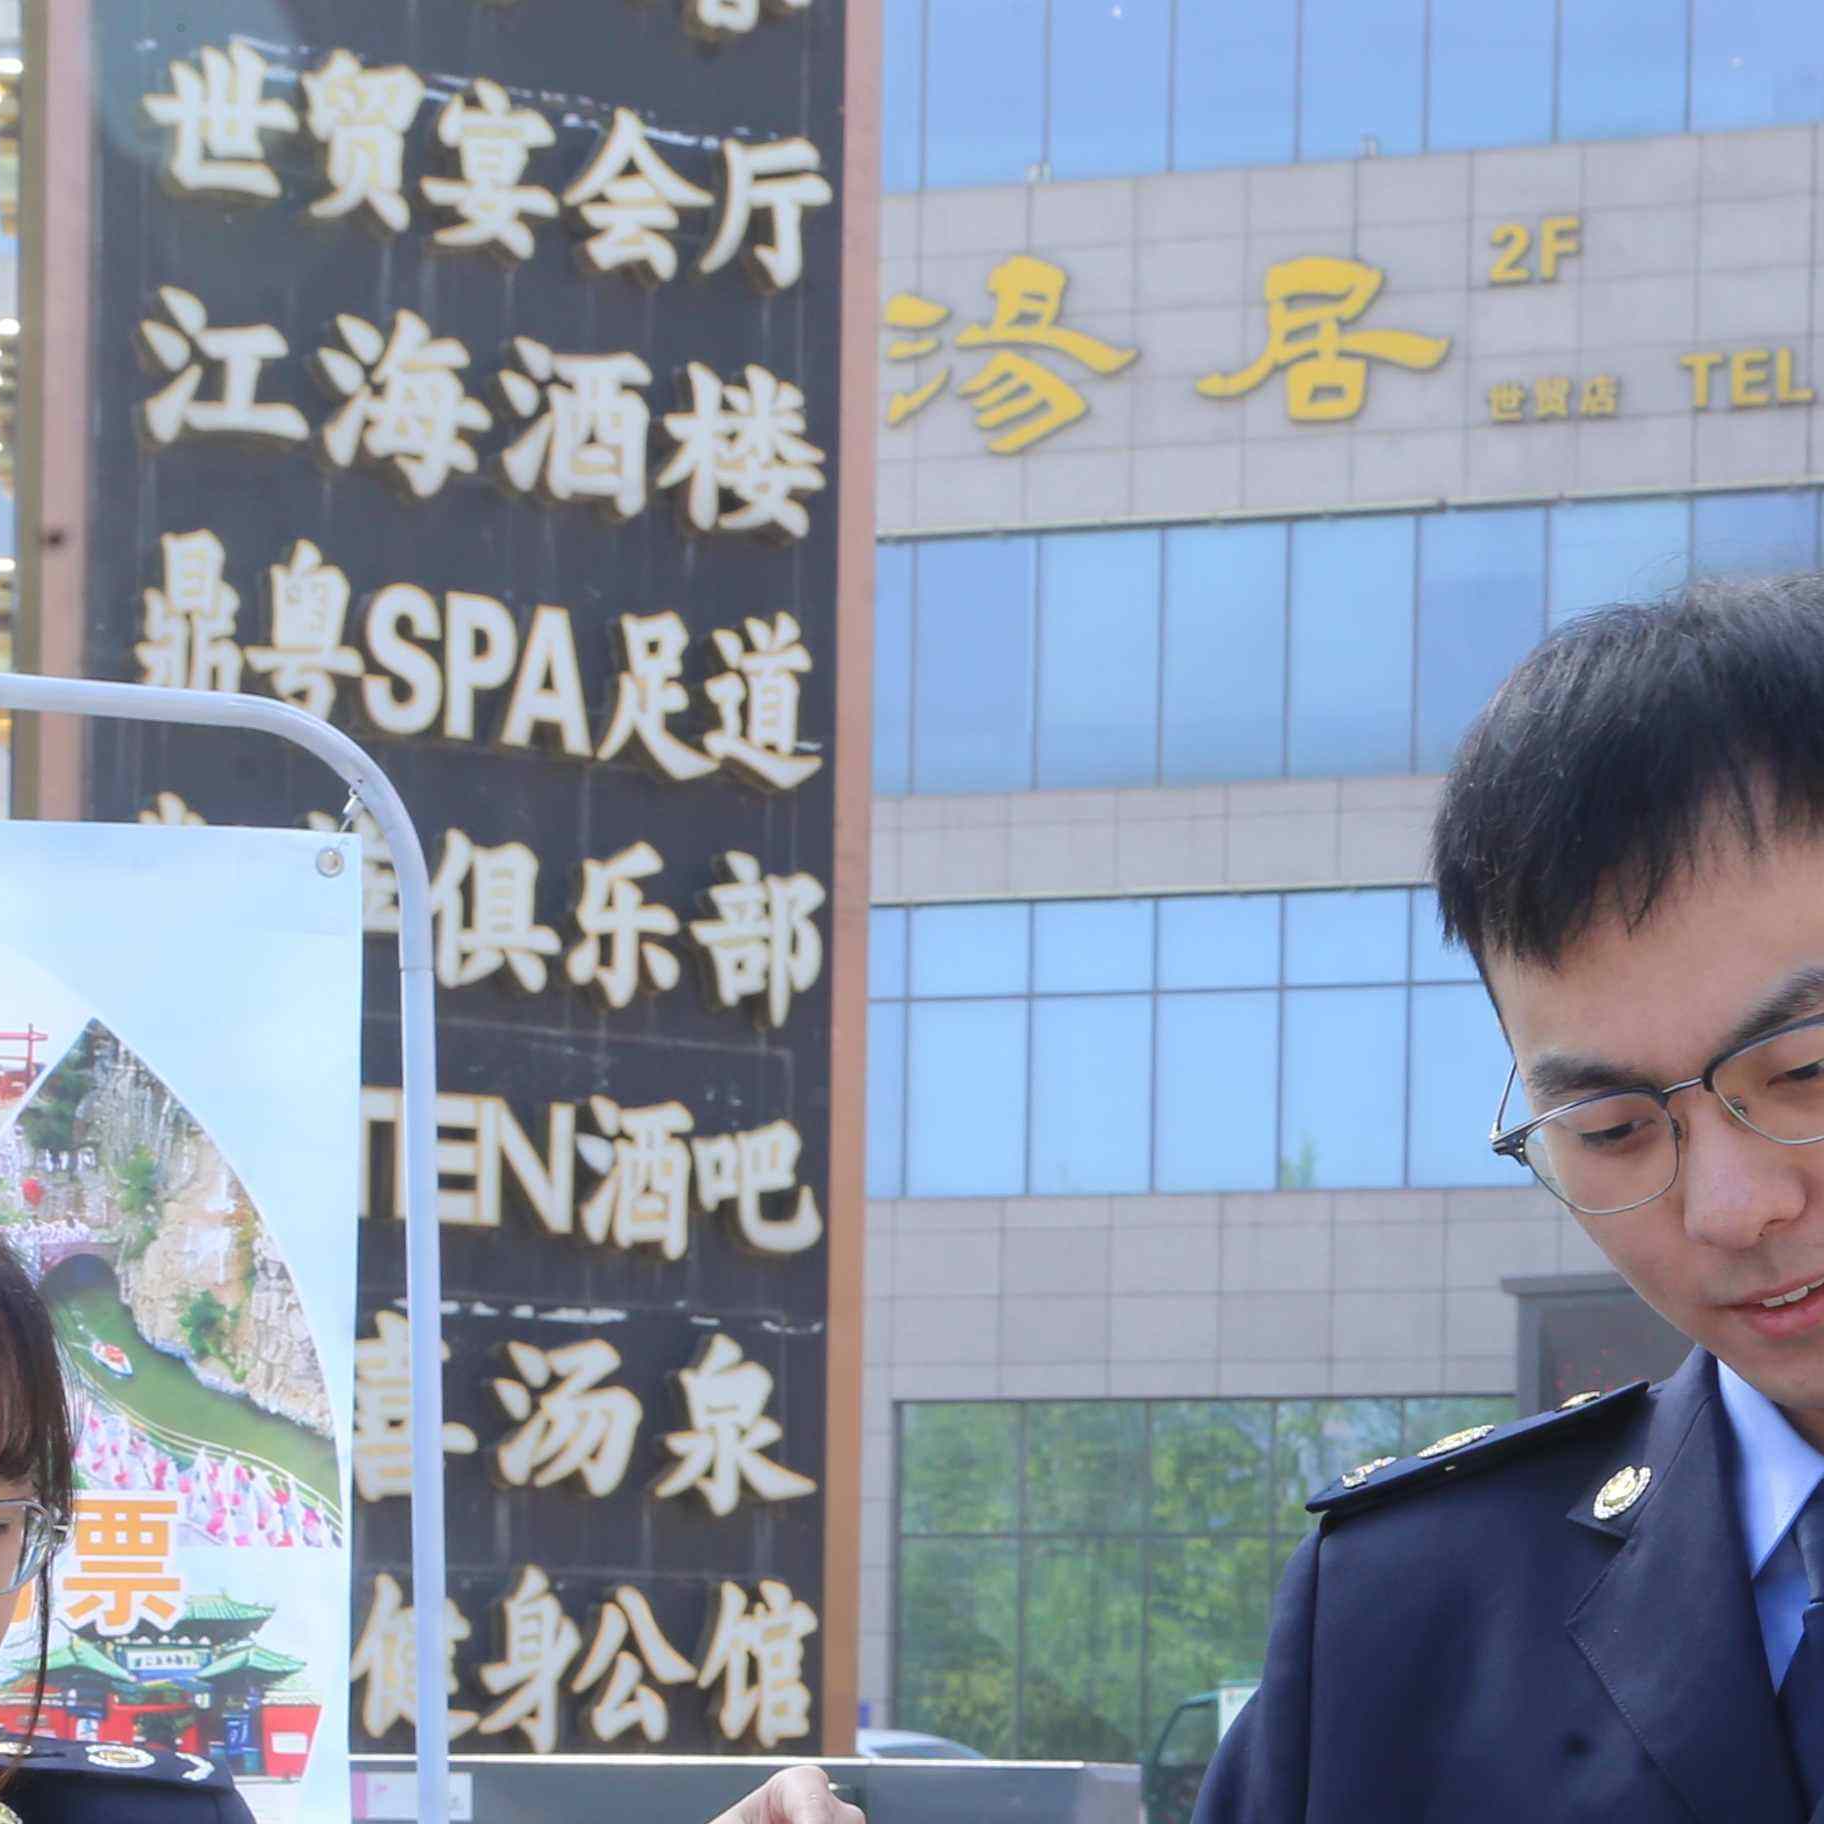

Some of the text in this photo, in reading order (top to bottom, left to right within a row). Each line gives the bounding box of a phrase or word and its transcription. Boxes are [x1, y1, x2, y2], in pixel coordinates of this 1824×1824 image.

[143, 42, 831, 286] 世贸宴会厅
[1489, 214, 1582, 285] 2F
[140, 285, 826, 541] 江海酒楼
[1679, 346, 1814, 408] TEL
